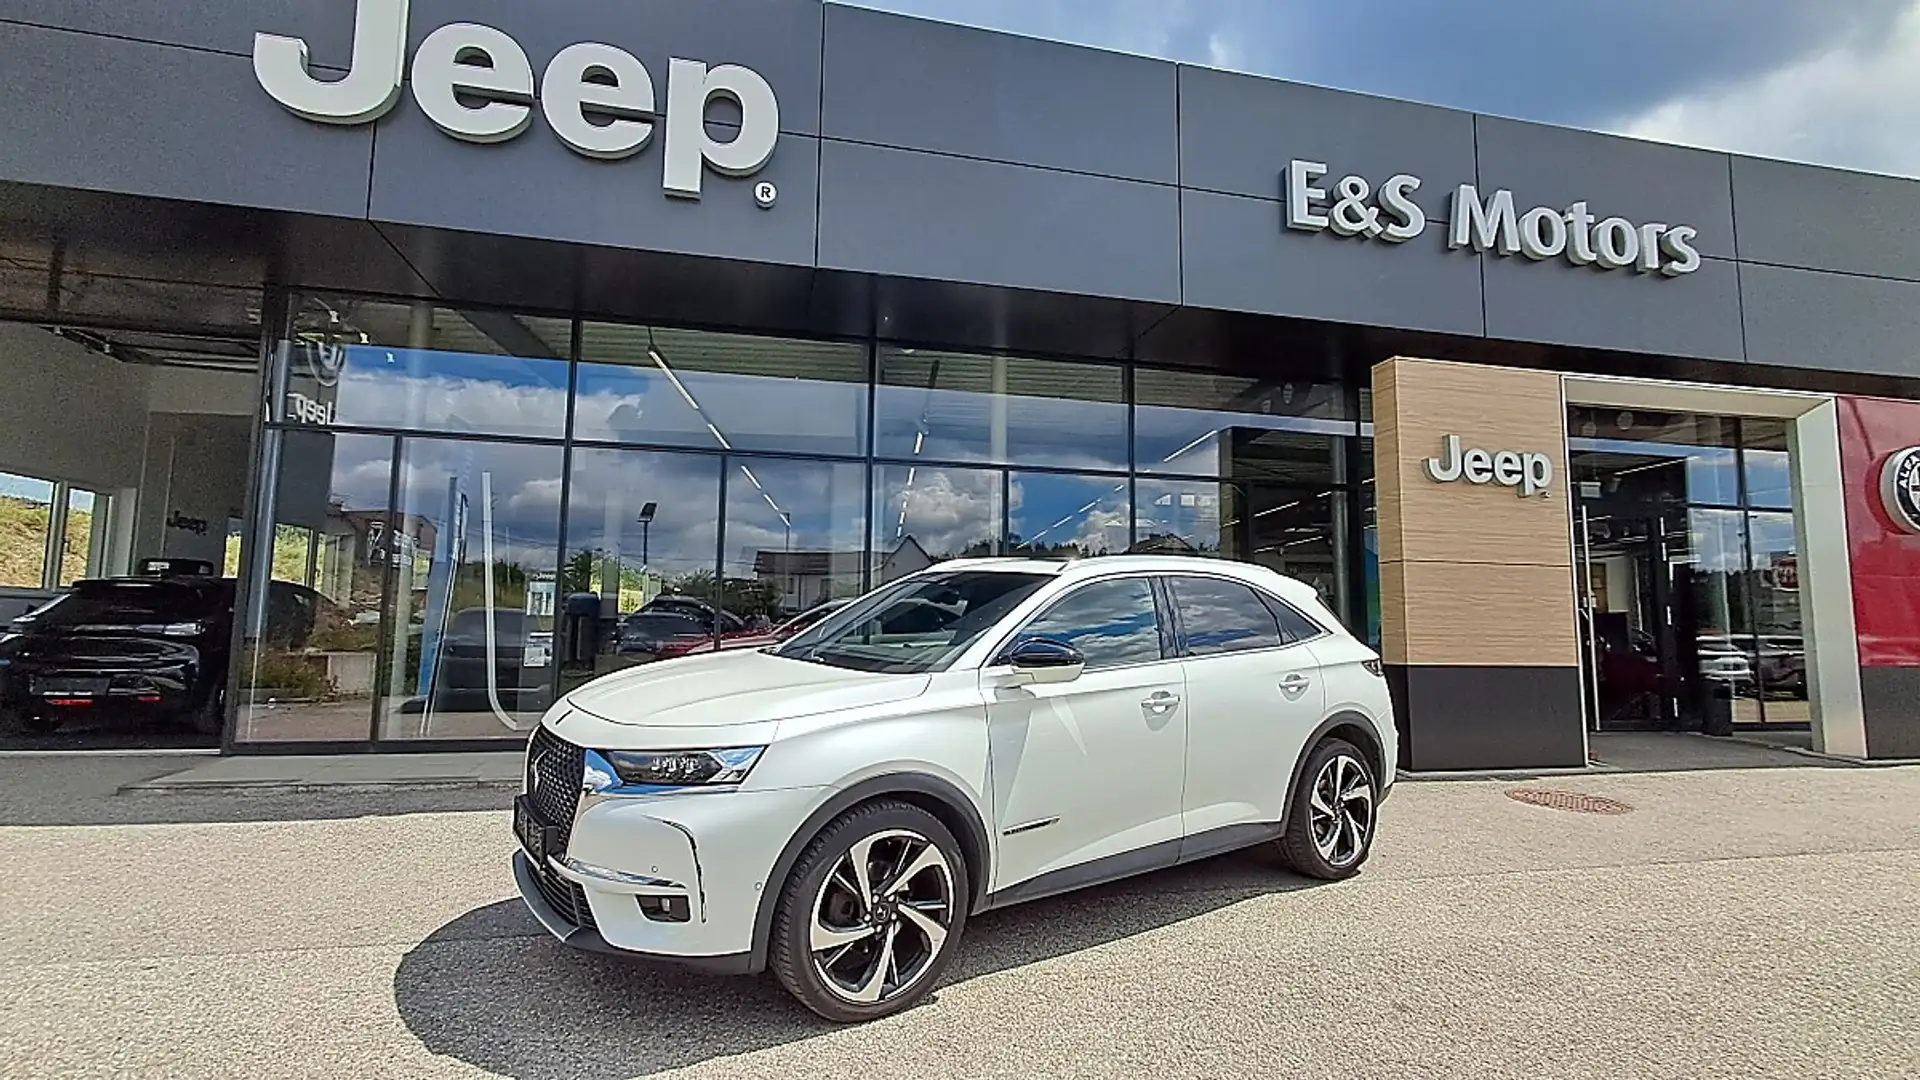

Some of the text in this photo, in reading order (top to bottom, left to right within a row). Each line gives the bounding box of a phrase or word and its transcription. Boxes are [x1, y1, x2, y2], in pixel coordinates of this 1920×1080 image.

[252, 0, 780, 199] Jeep
[1287, 160, 1701, 277] E&S Motors
[1422, 434, 1553, 498] Jeep
